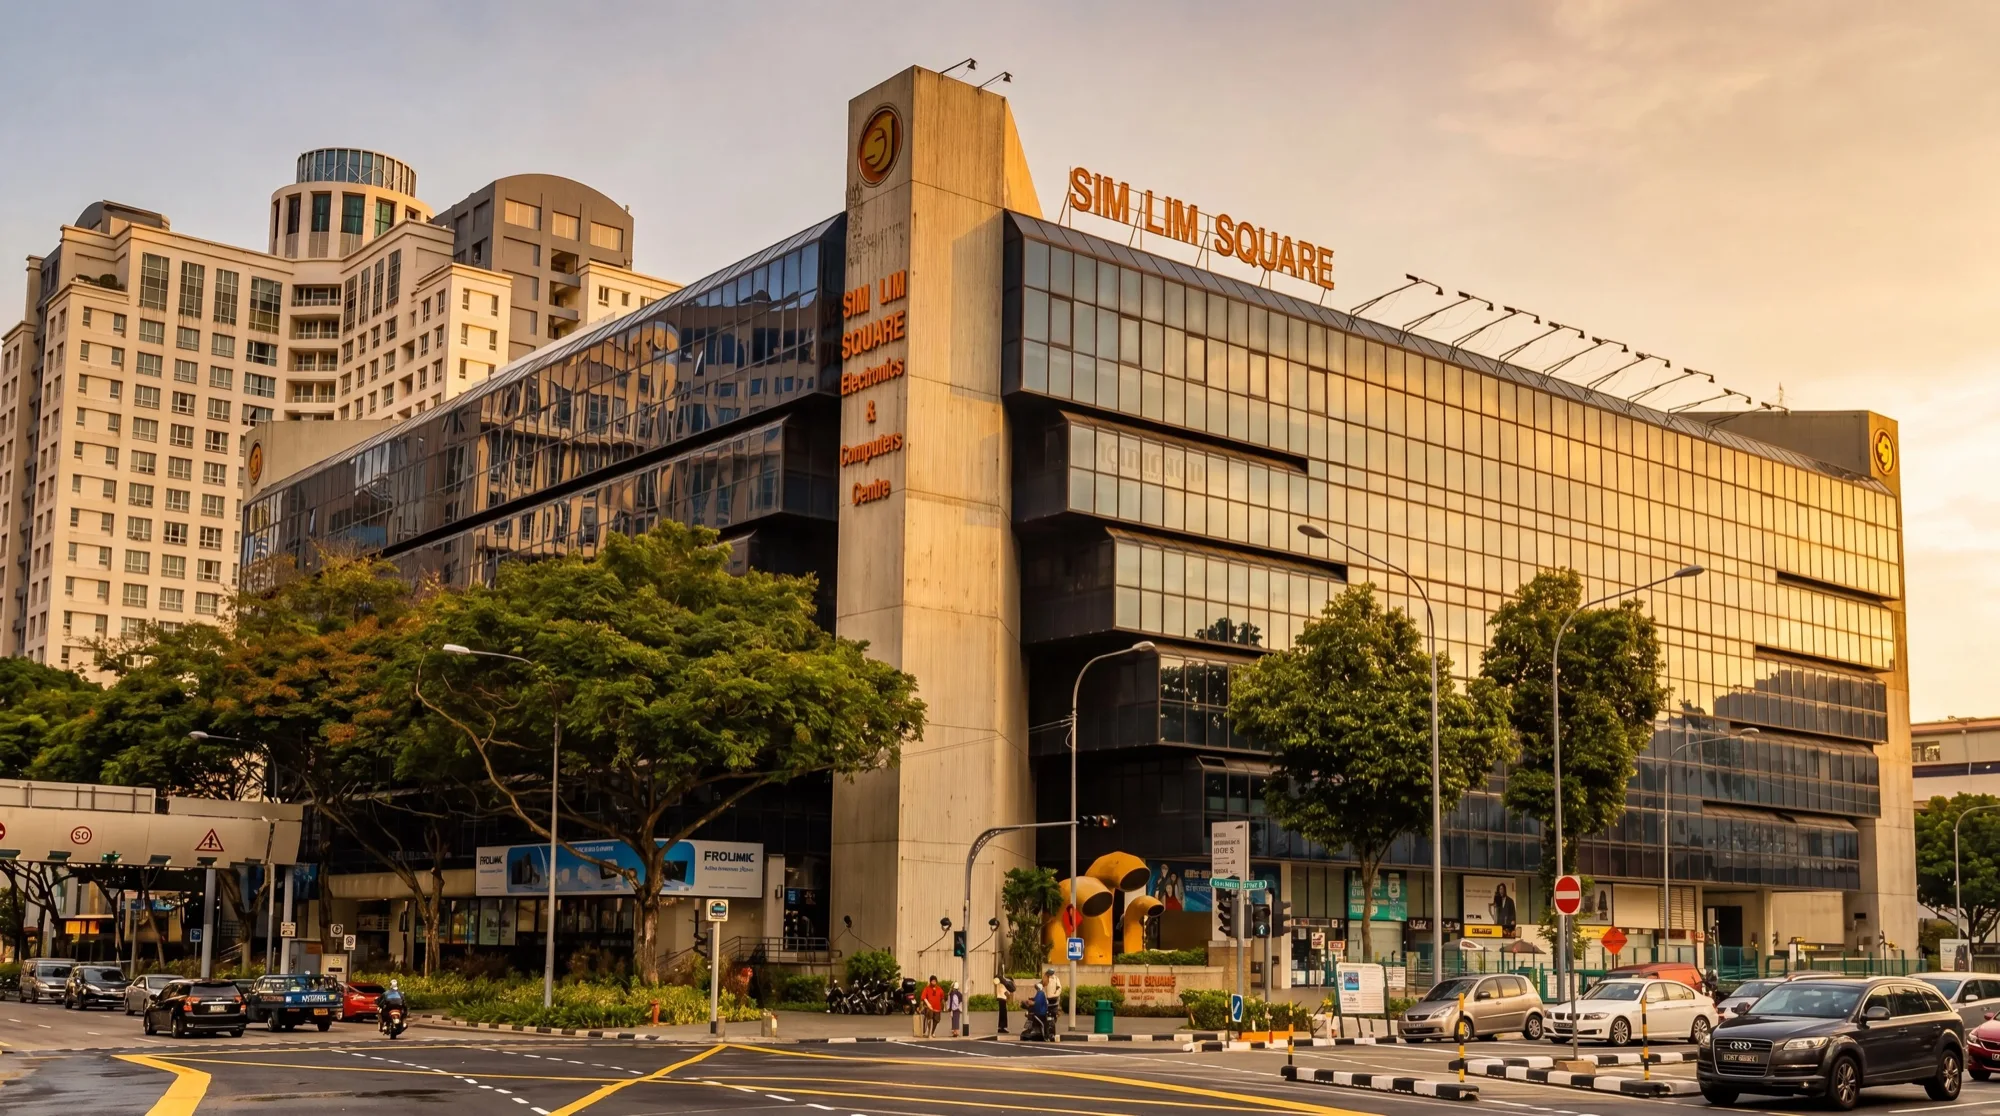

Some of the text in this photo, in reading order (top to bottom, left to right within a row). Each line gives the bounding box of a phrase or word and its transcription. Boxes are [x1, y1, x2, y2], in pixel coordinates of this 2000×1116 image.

[1070, 167, 1335, 290] SIM LIM SQUARE
[843, 269, 906, 319] SIM LIM
[841, 310, 905, 360] SQUARE
[841, 357, 904, 396] Electronics
[865, 400, 877, 422] &
[840, 432, 903, 467] Computers
[852, 478, 891, 506] Centre
